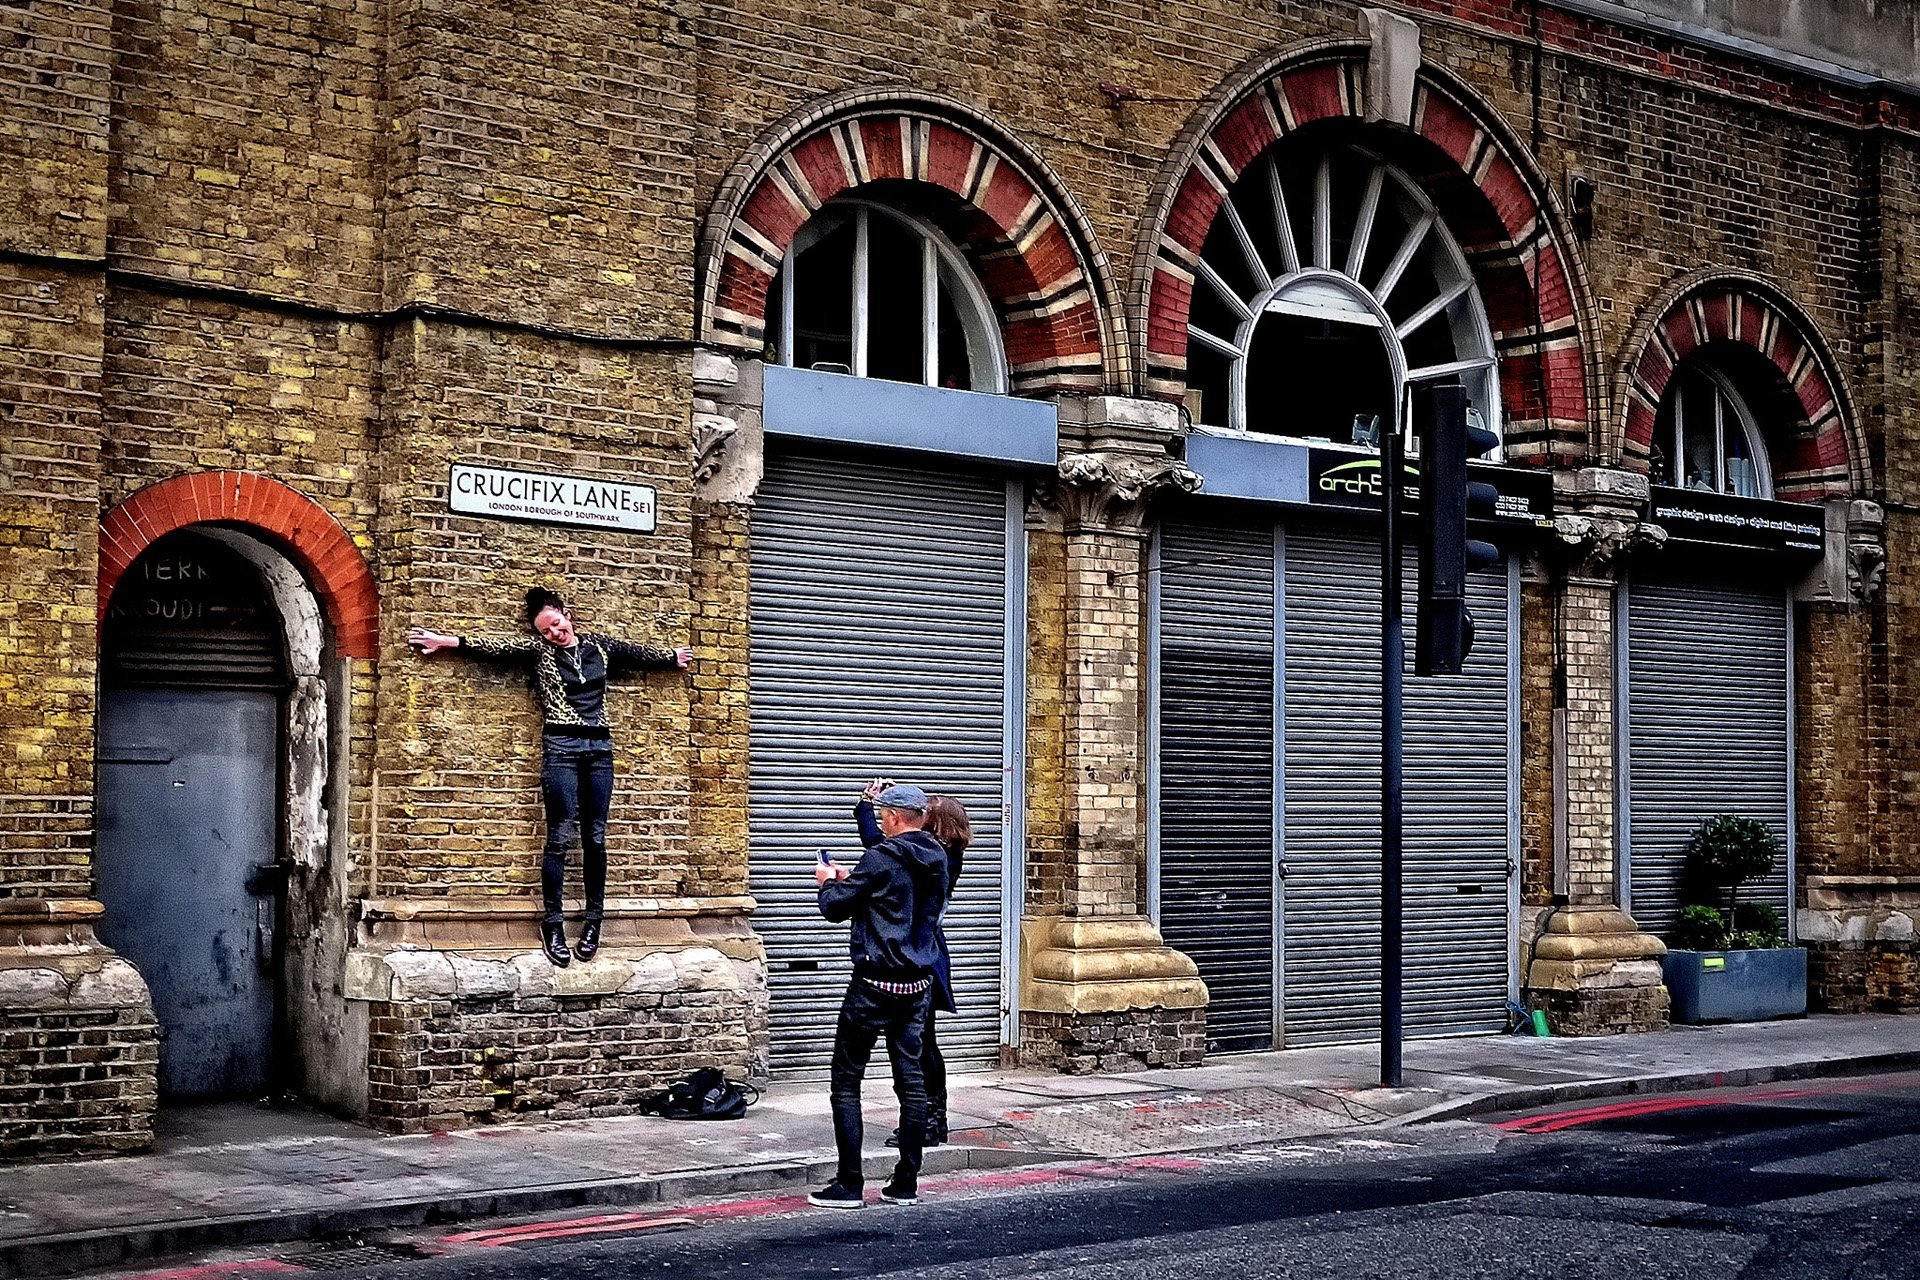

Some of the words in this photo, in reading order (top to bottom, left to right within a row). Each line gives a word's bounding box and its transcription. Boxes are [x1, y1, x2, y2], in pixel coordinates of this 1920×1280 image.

[457, 472, 565, 504] CRUCIFIX
[573, 484, 631, 511] LANE
[632, 501, 651, 514] SE1
[488, 502, 522, 512] LONDON
[524, 505, 562, 516] BOROUGH
[563, 510, 574, 518] OF
[575, 511, 620, 522] SOUTHWARK
[1682, 509, 1704, 521] design
[1724, 515, 1745, 526] design
